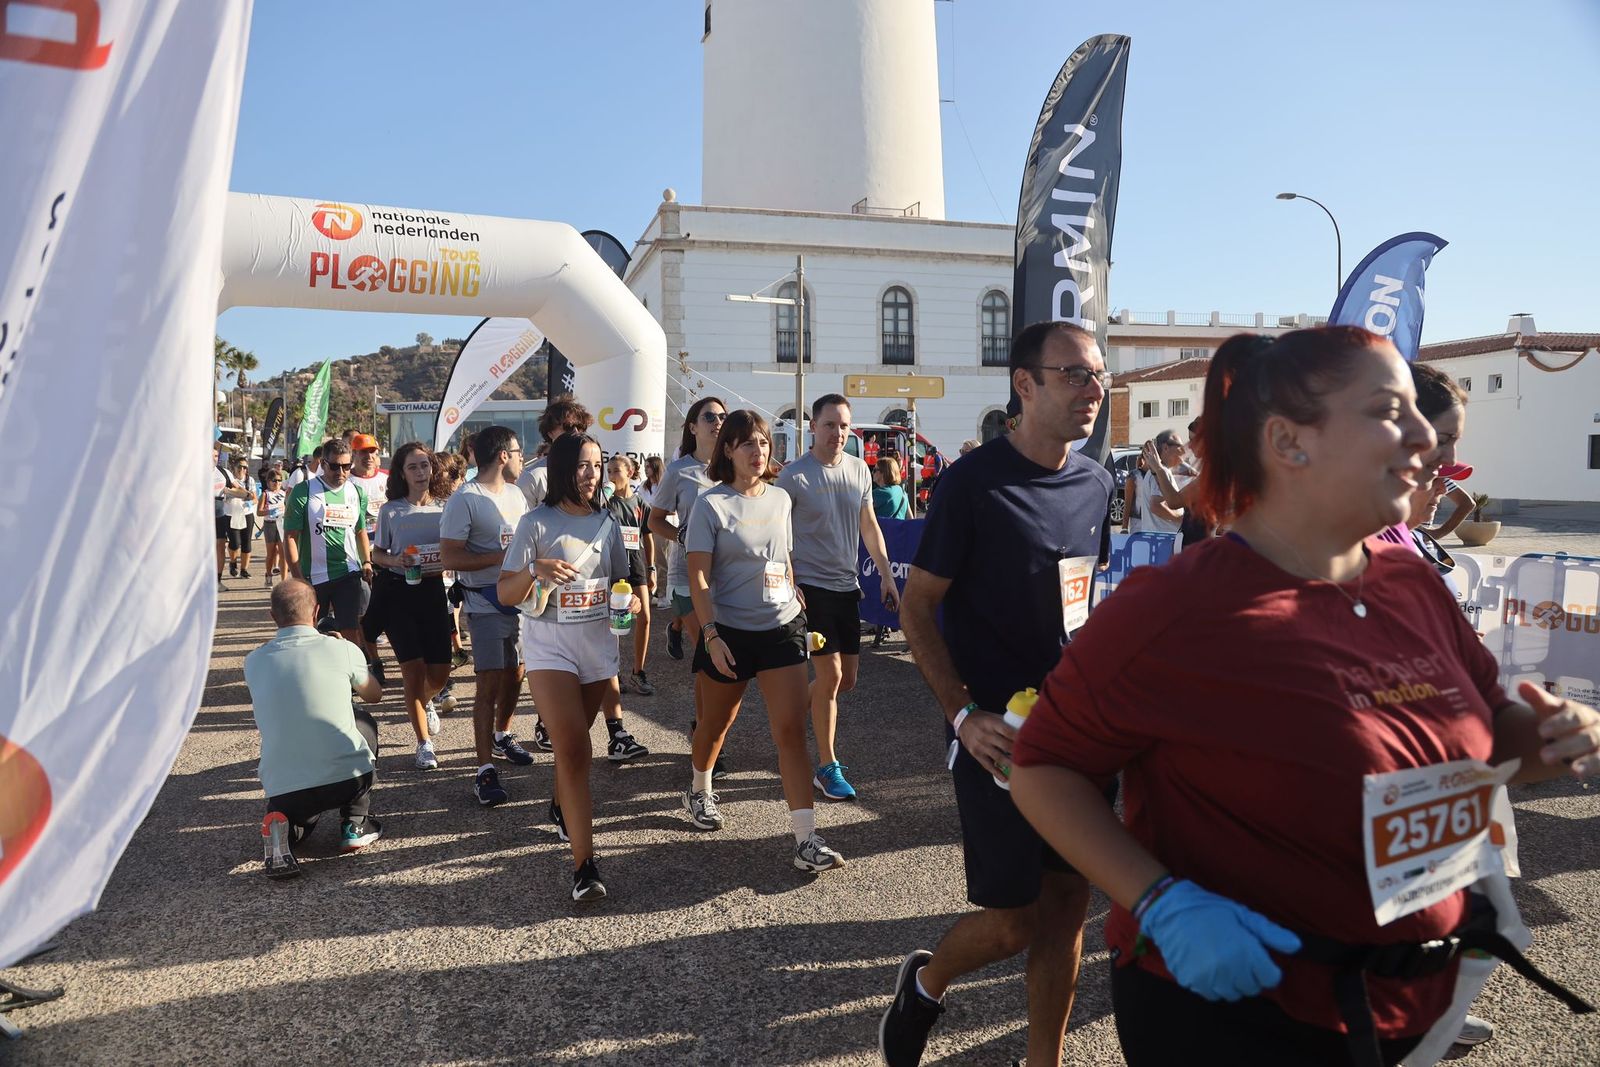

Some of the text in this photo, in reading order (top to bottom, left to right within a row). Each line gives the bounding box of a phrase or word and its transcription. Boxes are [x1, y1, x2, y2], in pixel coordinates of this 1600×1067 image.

[372, 212, 451, 226] nationale
[373, 223, 480, 242] nederlanden
[439, 247, 481, 262] TOUR
[309, 251, 481, 298] PLOGGING
[1364, 274, 1405, 339] ON
[888, 561, 912, 579] CAT
[564, 591, 604, 606] 25765
[1344, 690, 1372, 710] in
[1385, 793, 1482, 858] 25761
